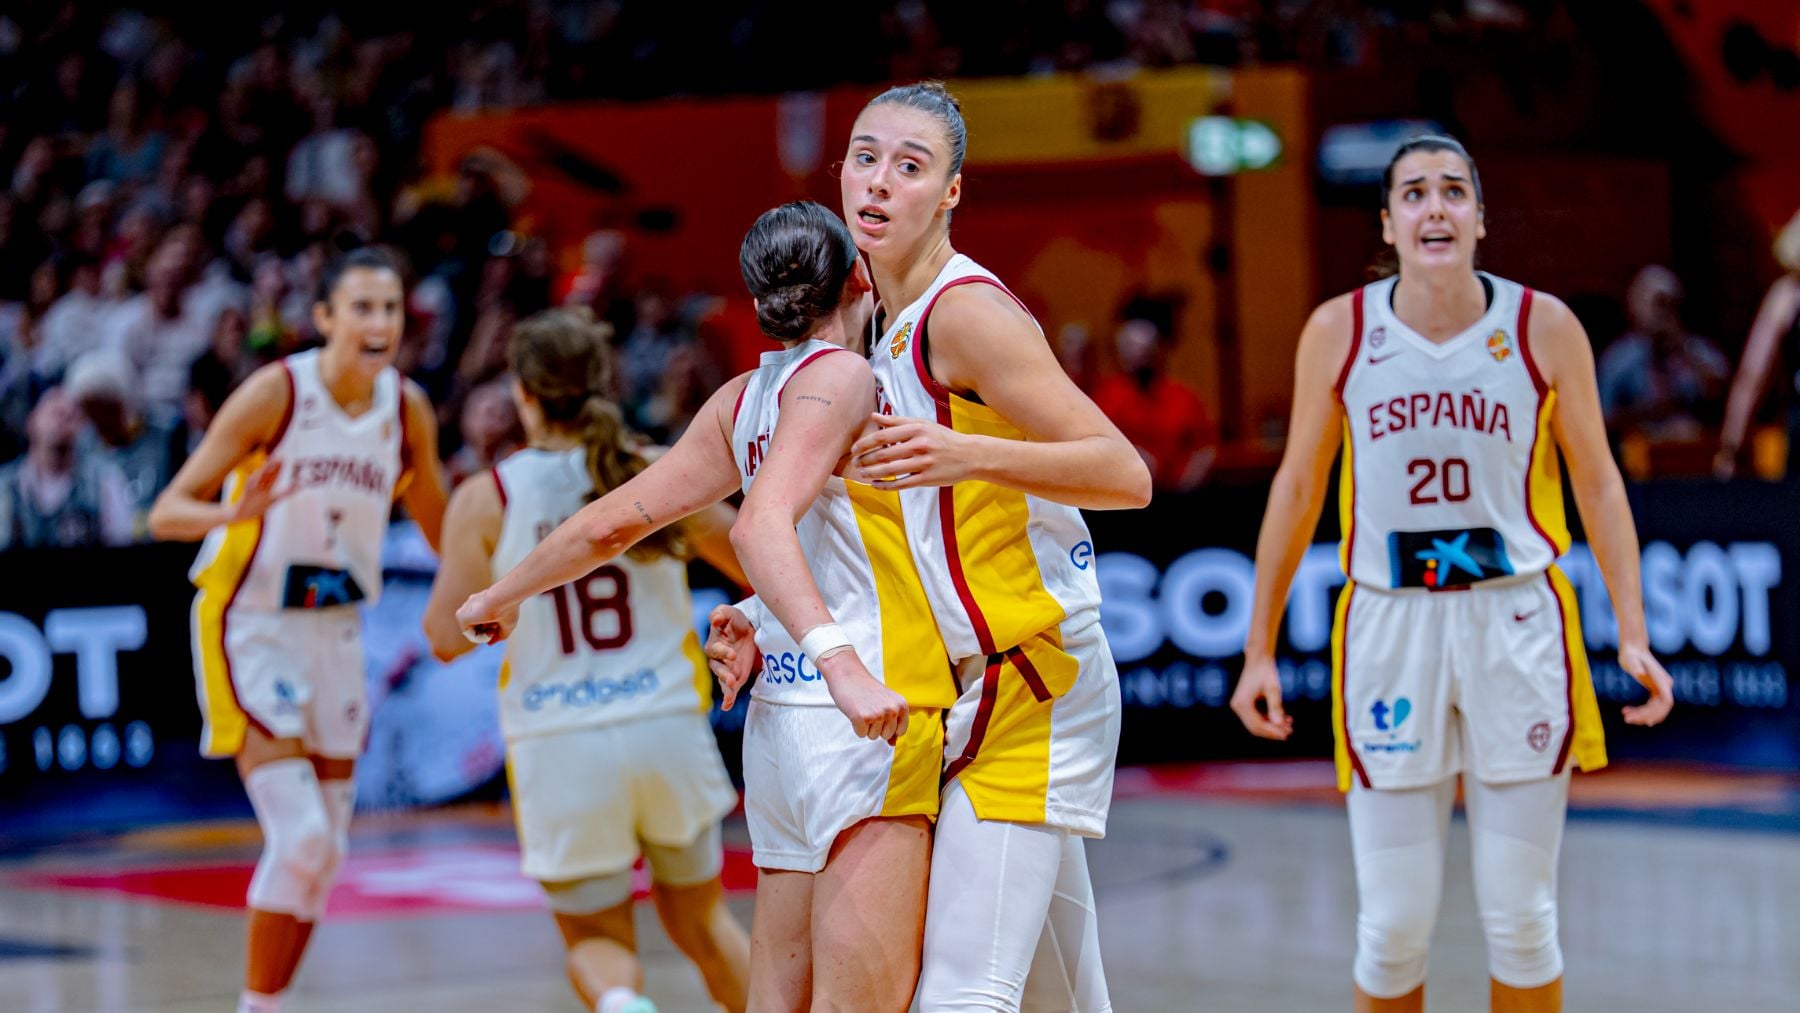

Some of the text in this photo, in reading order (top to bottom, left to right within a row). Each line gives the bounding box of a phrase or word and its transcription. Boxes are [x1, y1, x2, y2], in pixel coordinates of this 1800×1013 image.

[1369, 388, 1513, 442] ESPAÑA
[1407, 457, 1471, 506] 20
[540, 564, 633, 655] 18
